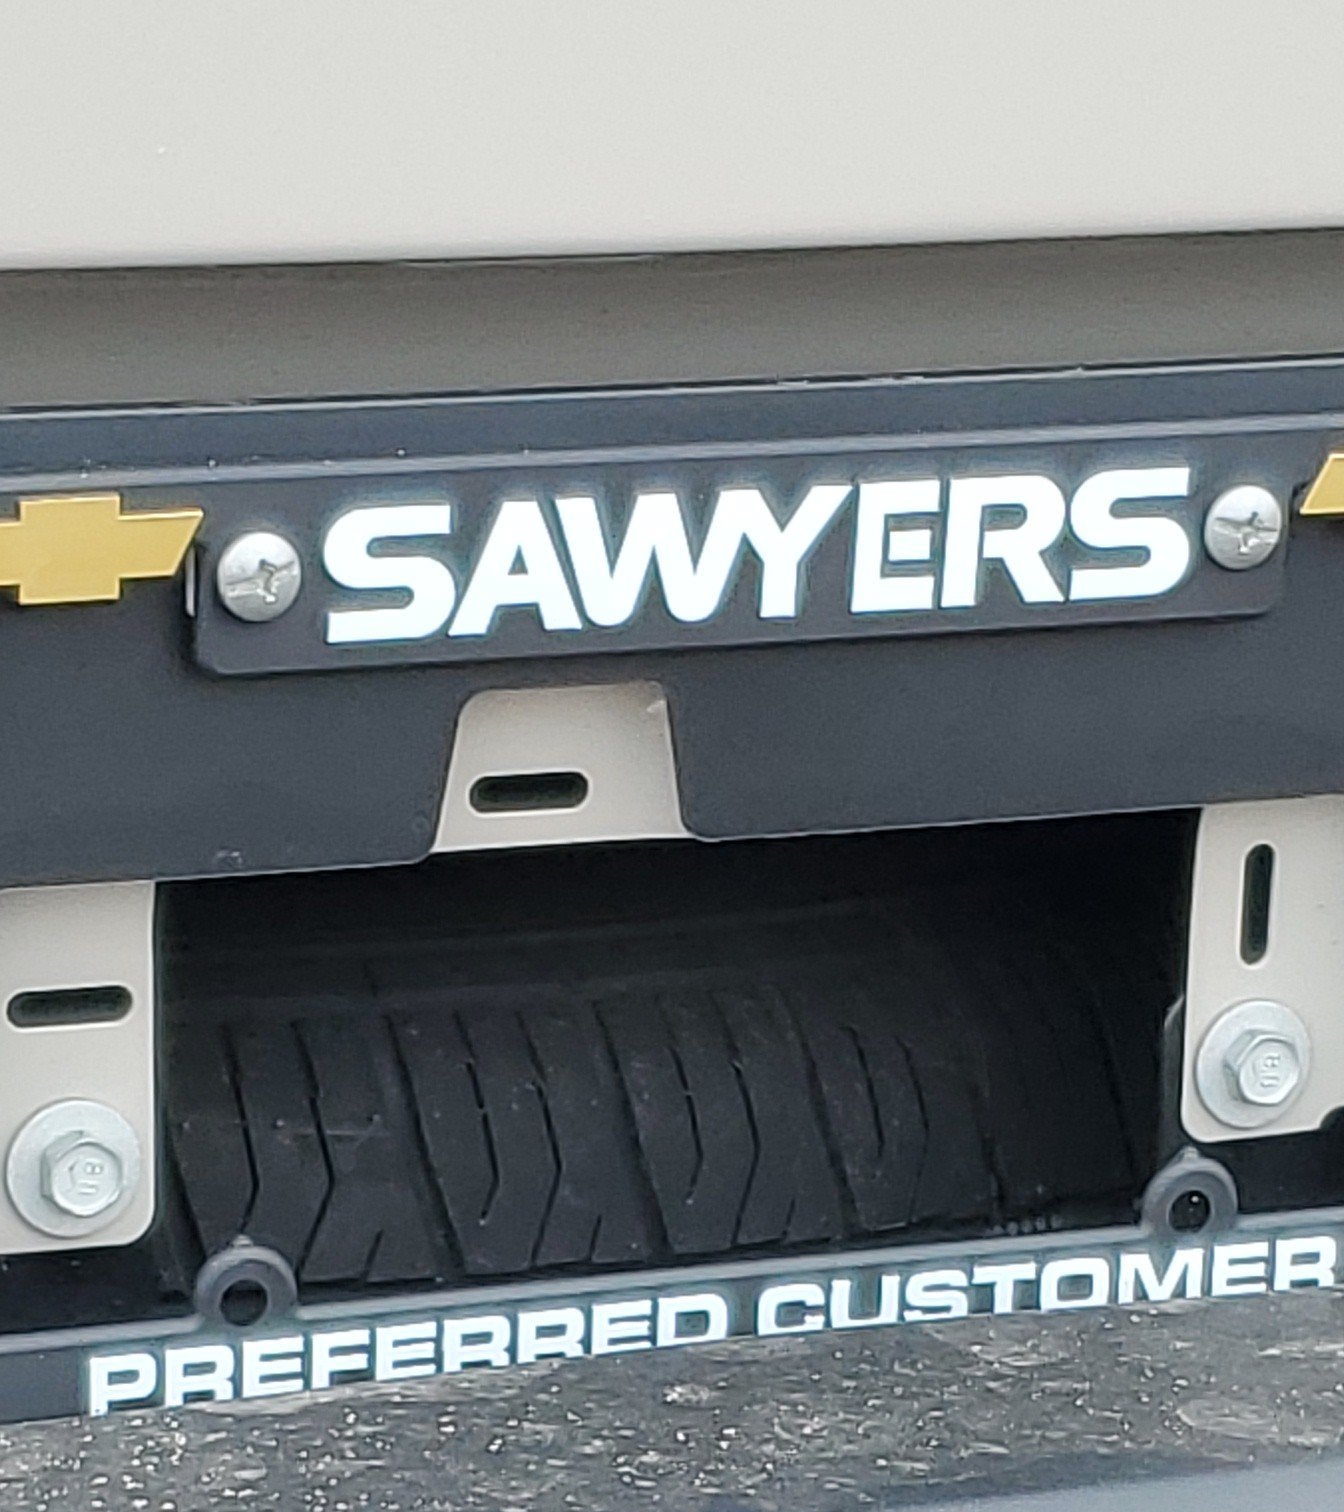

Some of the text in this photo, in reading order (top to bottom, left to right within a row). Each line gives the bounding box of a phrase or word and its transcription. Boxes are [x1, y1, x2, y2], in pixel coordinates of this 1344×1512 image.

[322, 465, 1192, 644] SAWYERS
[87, 1234, 1338, 1417] PREFERRED CUSTOMER
